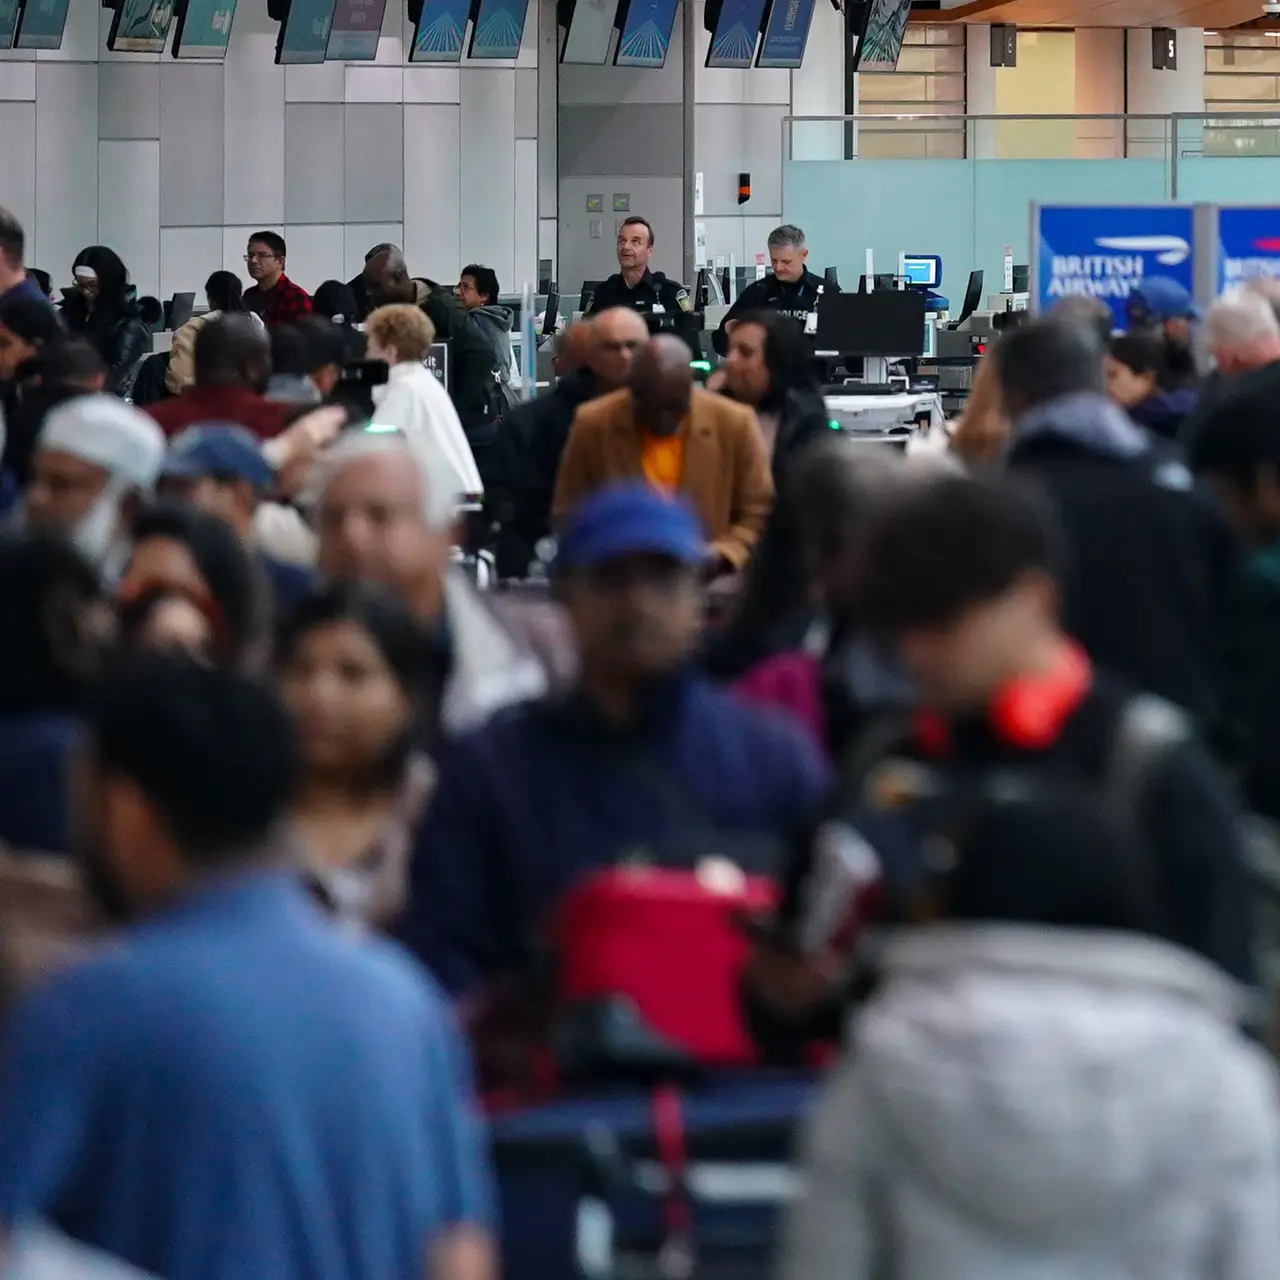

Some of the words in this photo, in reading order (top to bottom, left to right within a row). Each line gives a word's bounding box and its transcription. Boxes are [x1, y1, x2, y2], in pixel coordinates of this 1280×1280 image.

[1168, 40, 1175, 58] 5
[1051, 254, 1144, 277] BRITISH
[422, 356, 437, 367] xit
